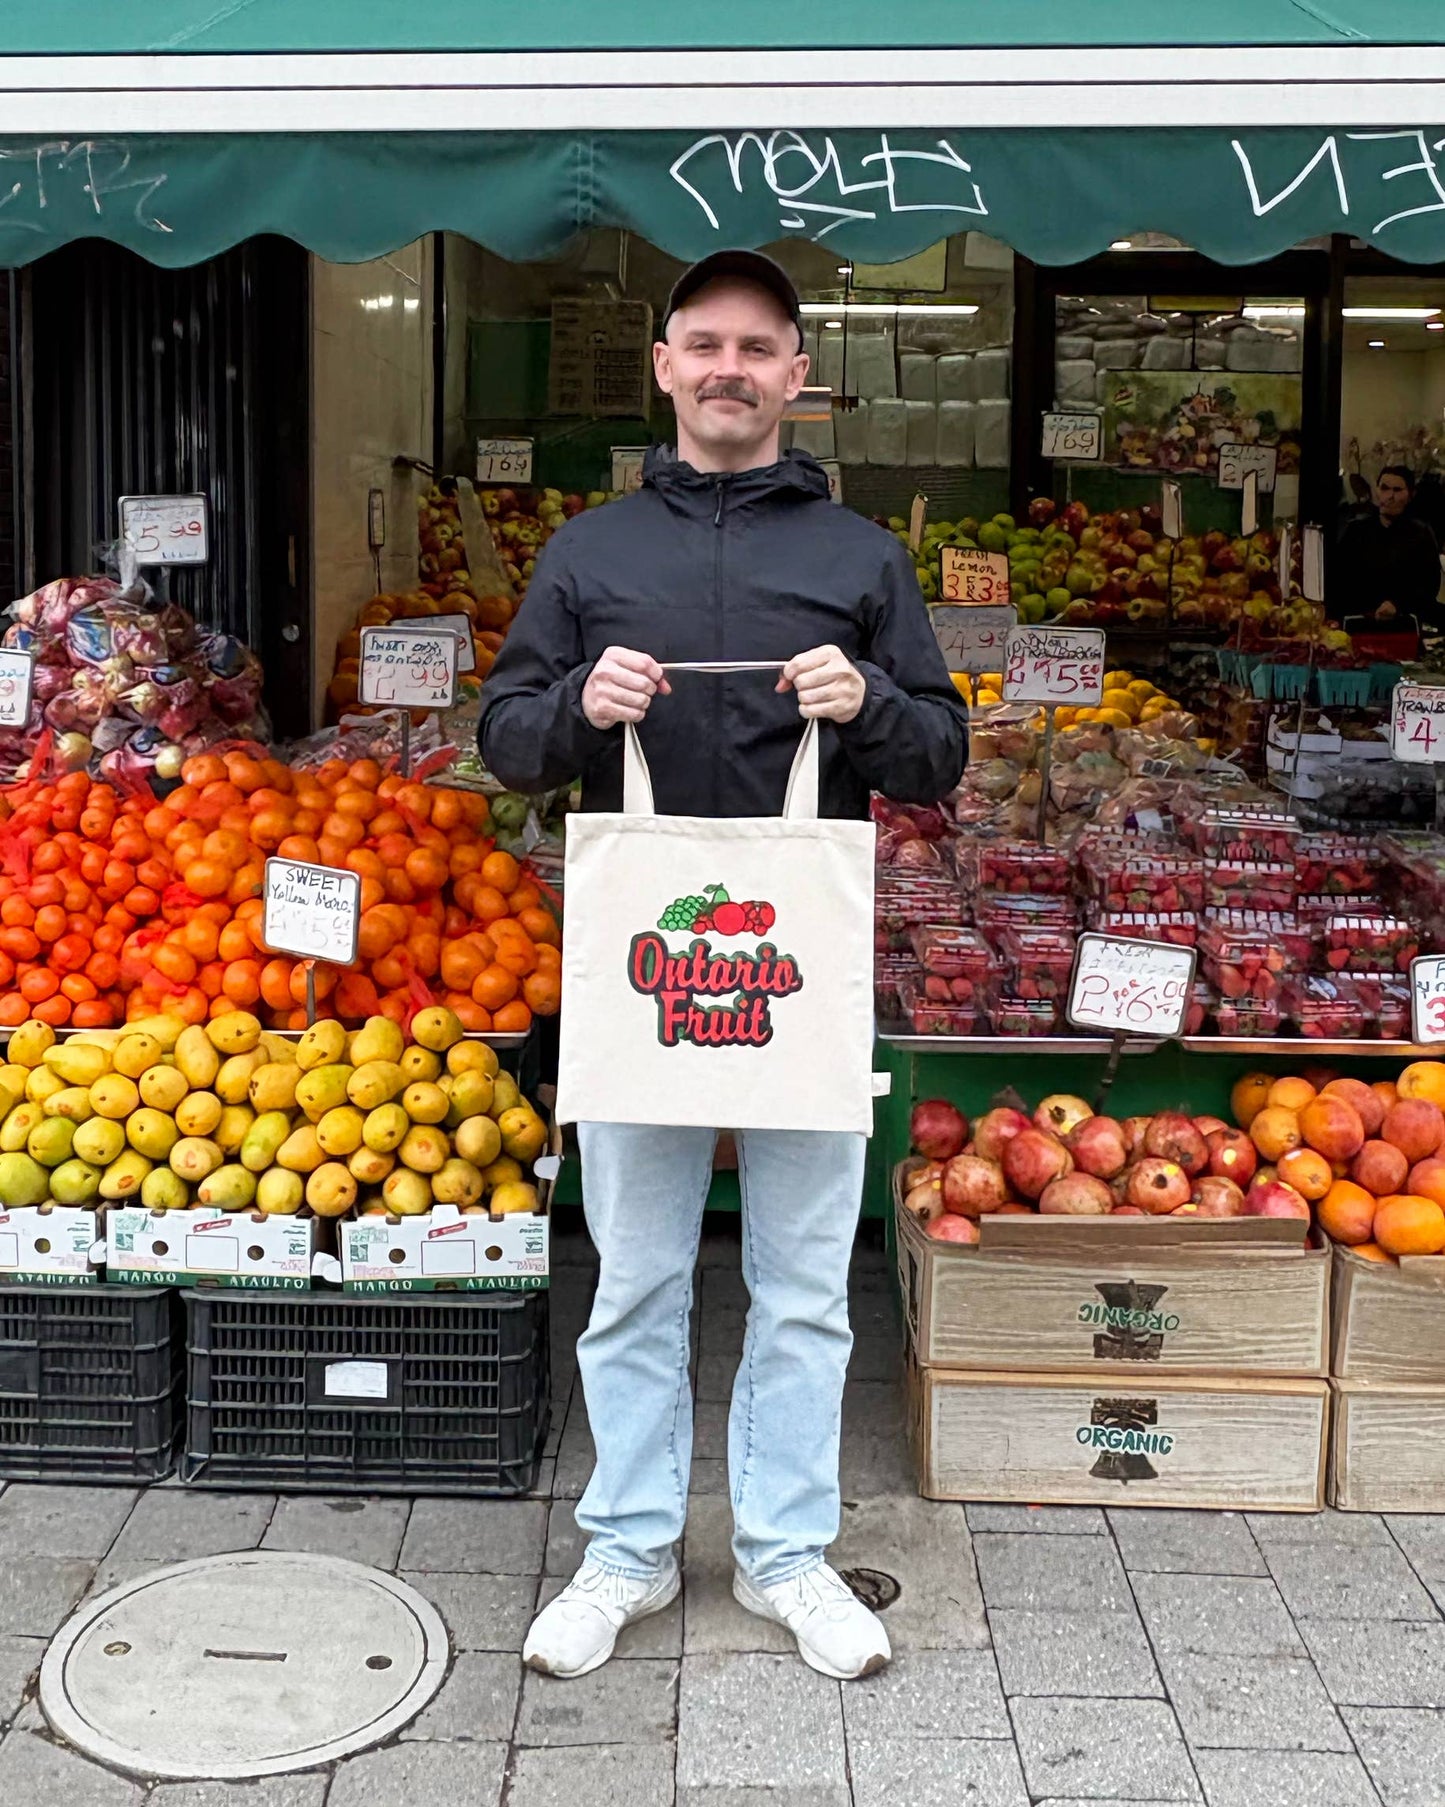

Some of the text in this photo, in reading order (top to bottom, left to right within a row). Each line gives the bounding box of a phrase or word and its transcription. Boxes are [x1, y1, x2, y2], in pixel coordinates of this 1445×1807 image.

[978, 576, 993, 602] 3
[285, 866, 342, 893] SWEET
[629, 932, 802, 996] Ontario
[1075, 975, 1110, 1016] 2
[657, 988, 773, 1047] Fruit
[1078, 1303, 1180, 1331] ORGANIC
[1076, 1427, 1174, 1456] ORGANIC
